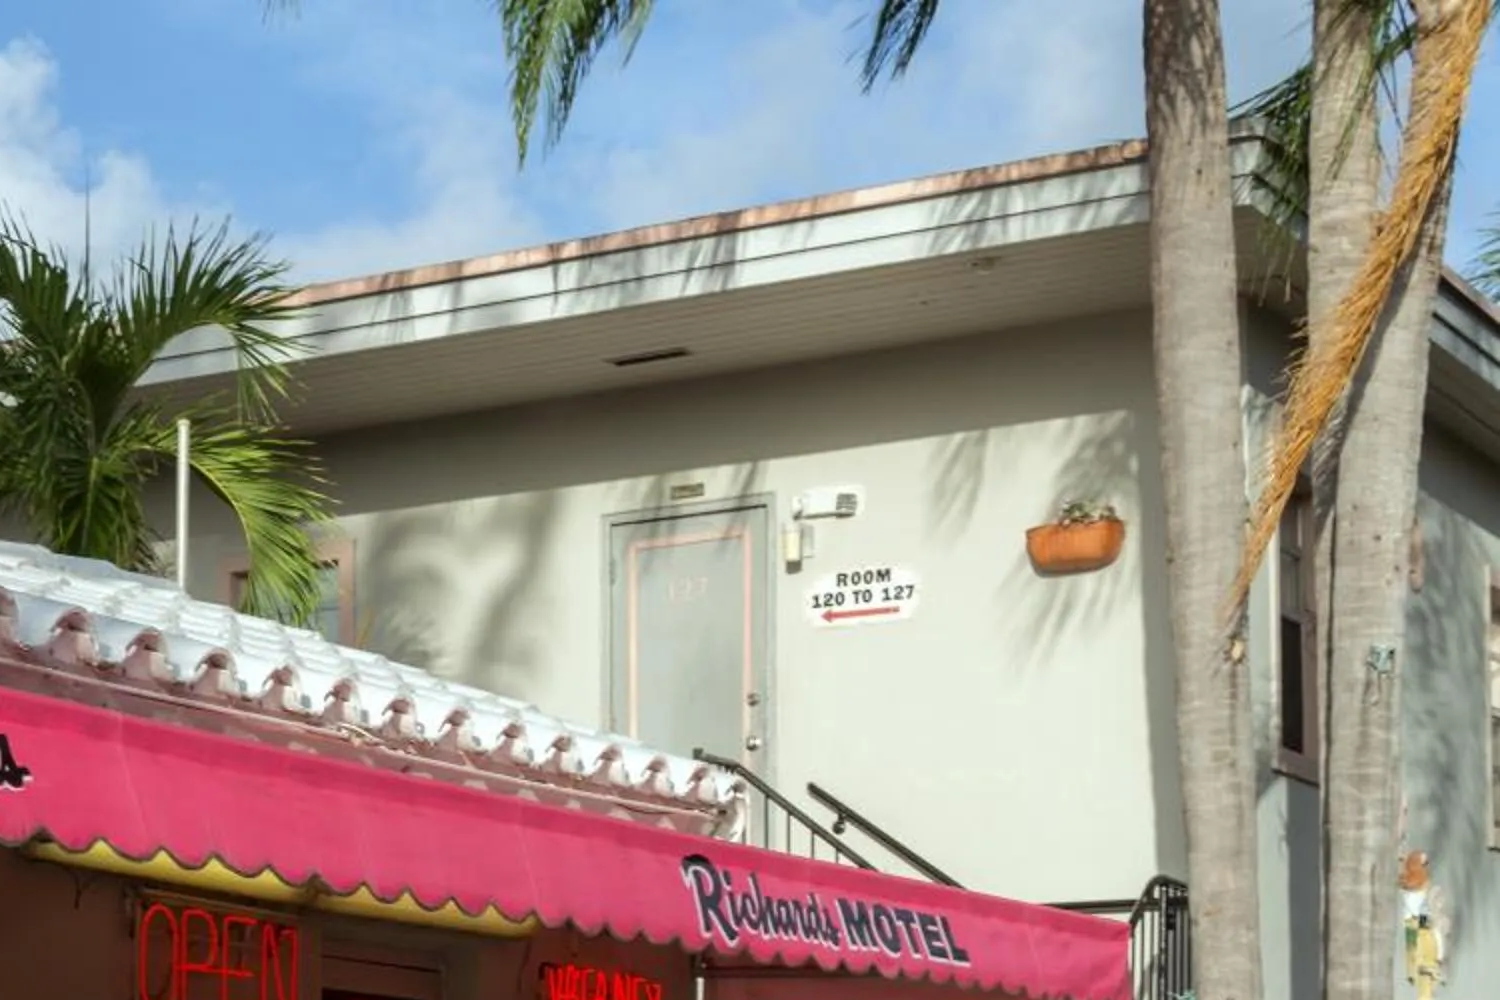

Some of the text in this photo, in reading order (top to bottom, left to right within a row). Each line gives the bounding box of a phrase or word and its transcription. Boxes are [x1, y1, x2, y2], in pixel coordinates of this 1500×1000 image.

[836, 568, 891, 588] ROOM
[811, 584, 915, 609] 120 TO 127
[835, 898, 972, 967] MOTEL
